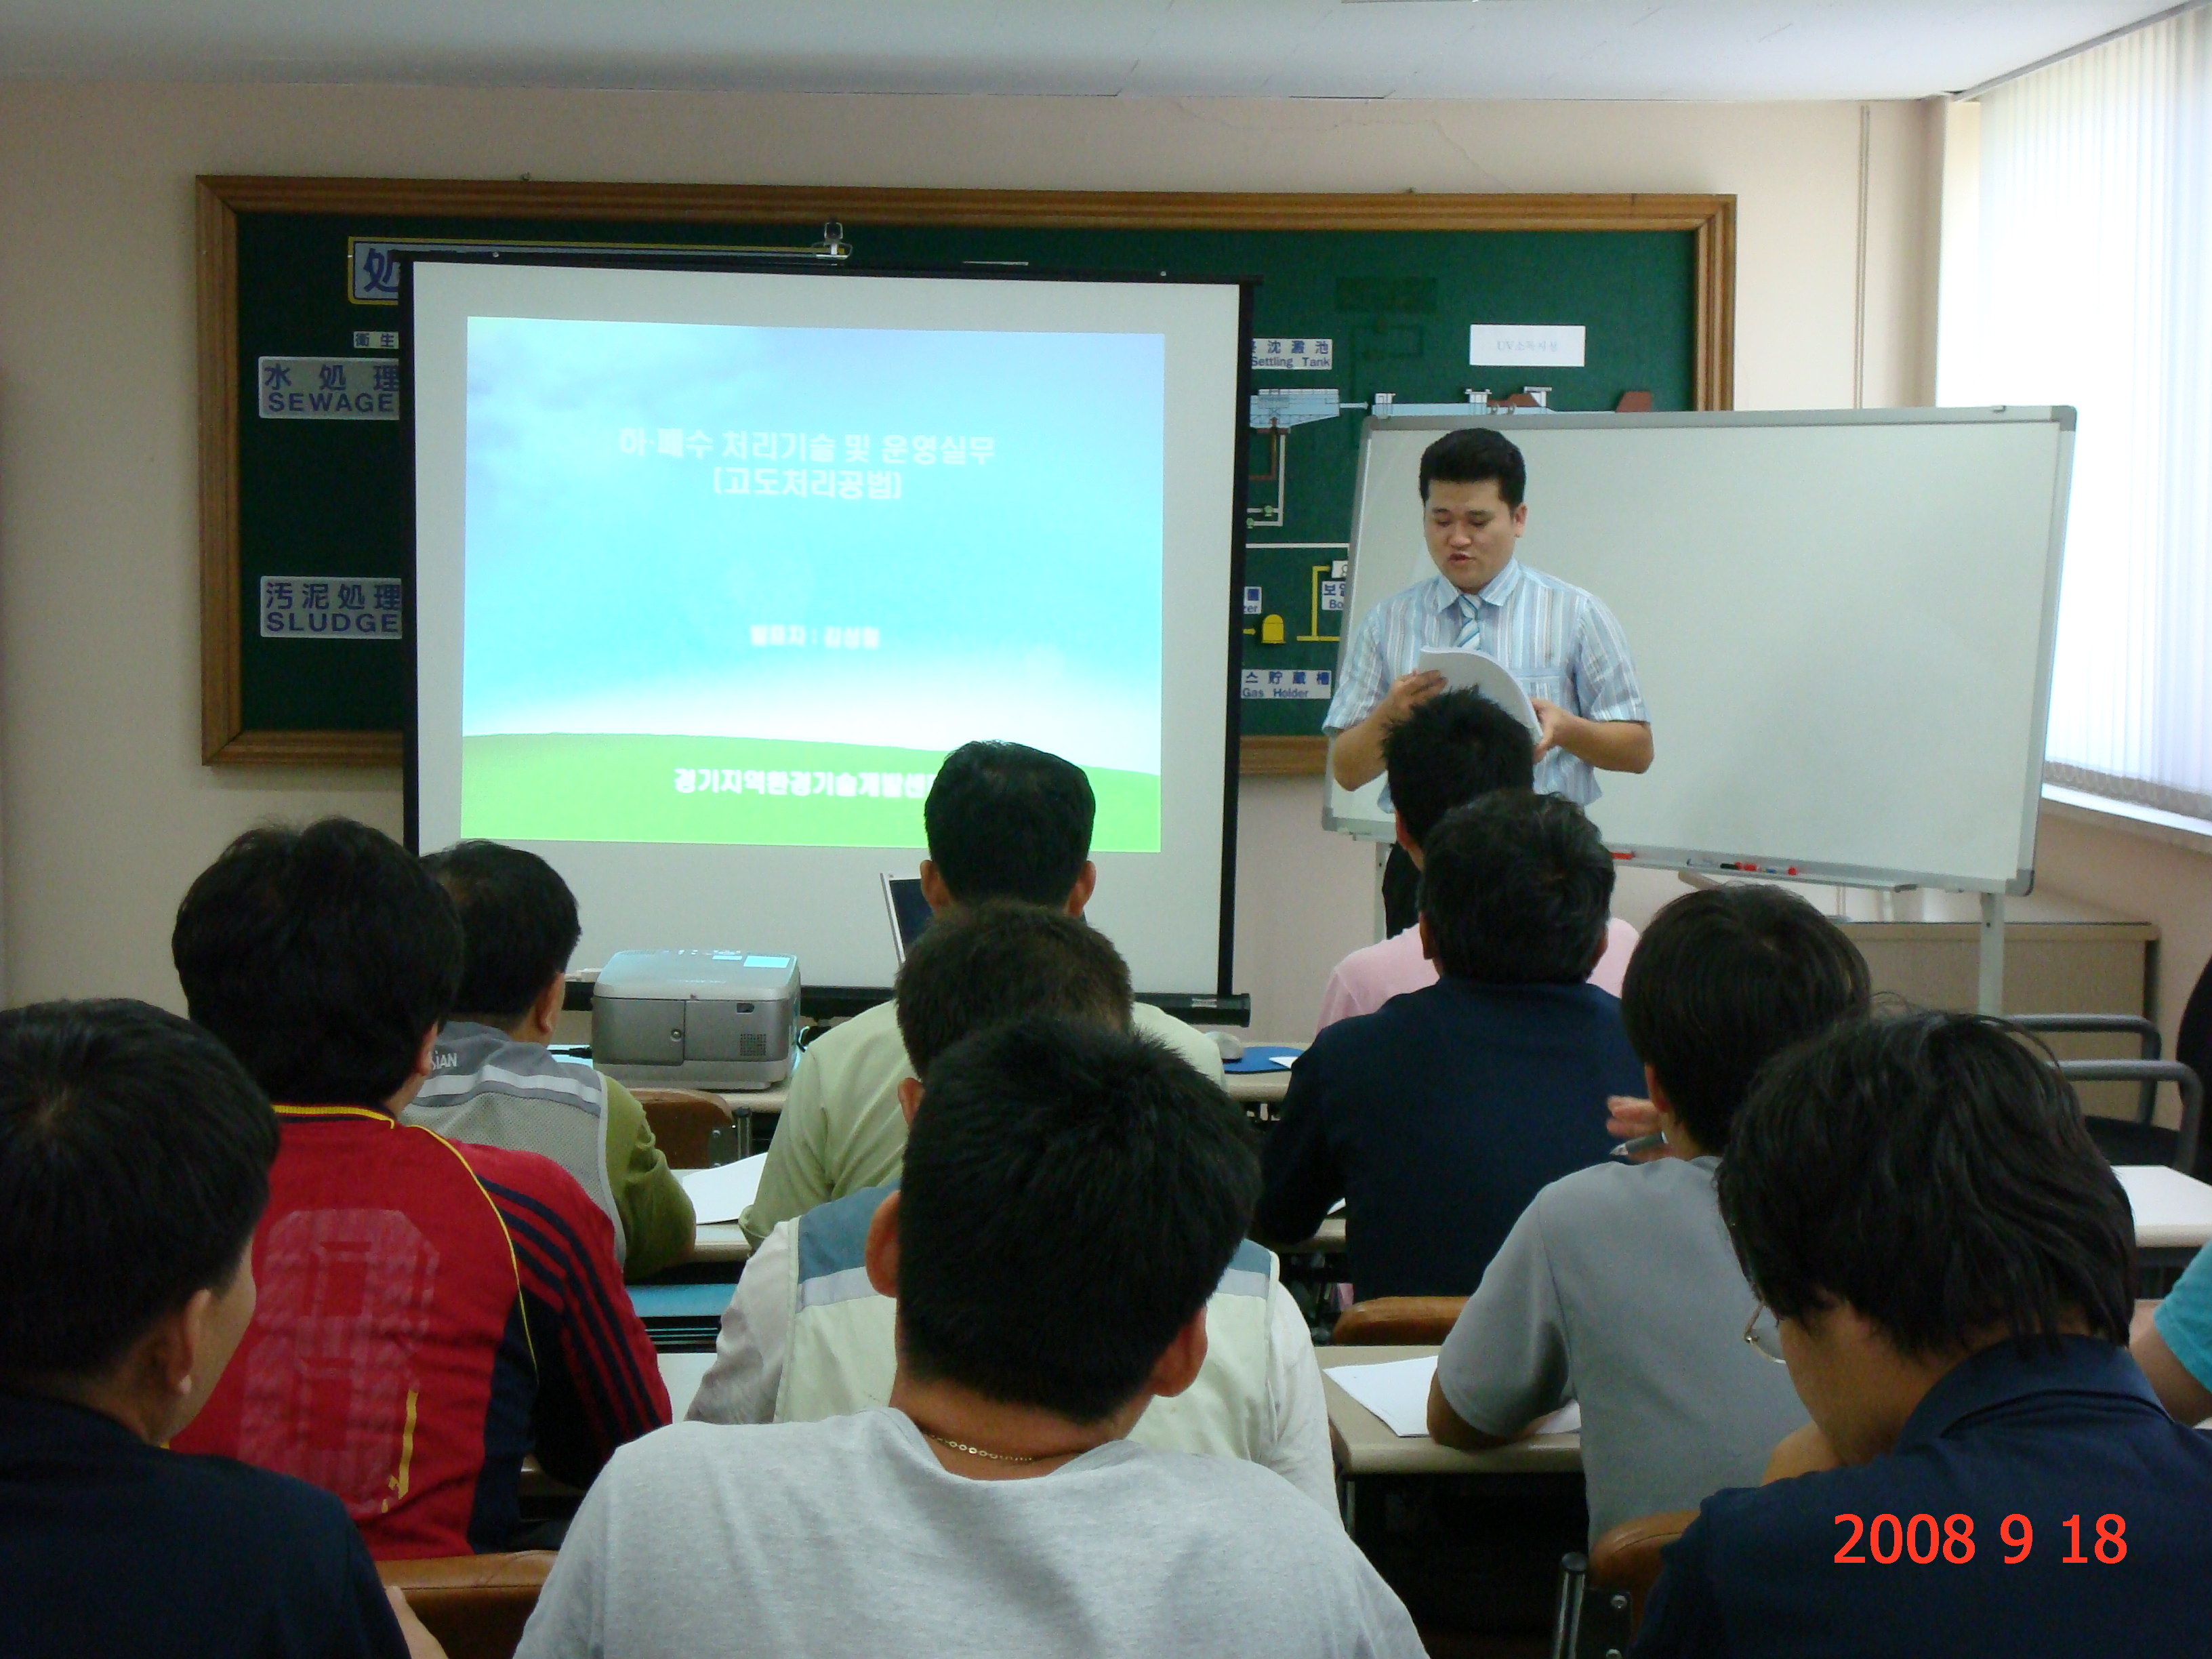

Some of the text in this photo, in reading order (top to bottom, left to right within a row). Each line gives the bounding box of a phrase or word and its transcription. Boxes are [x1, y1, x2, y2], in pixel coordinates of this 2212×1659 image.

[1252, 356, 1330, 368] Settling Tank
[268, 392, 394, 412] SEWAGE
[721, 430, 836, 463] 처리기술
[844, 434, 870, 464] 및
[881, 434, 995, 466] 운영실무
[266, 611, 398, 632] SLUDGE
[1243, 688, 1309, 697] Gas Holder
[674, 768, 937, 798] 경기지역환경기술개발센
